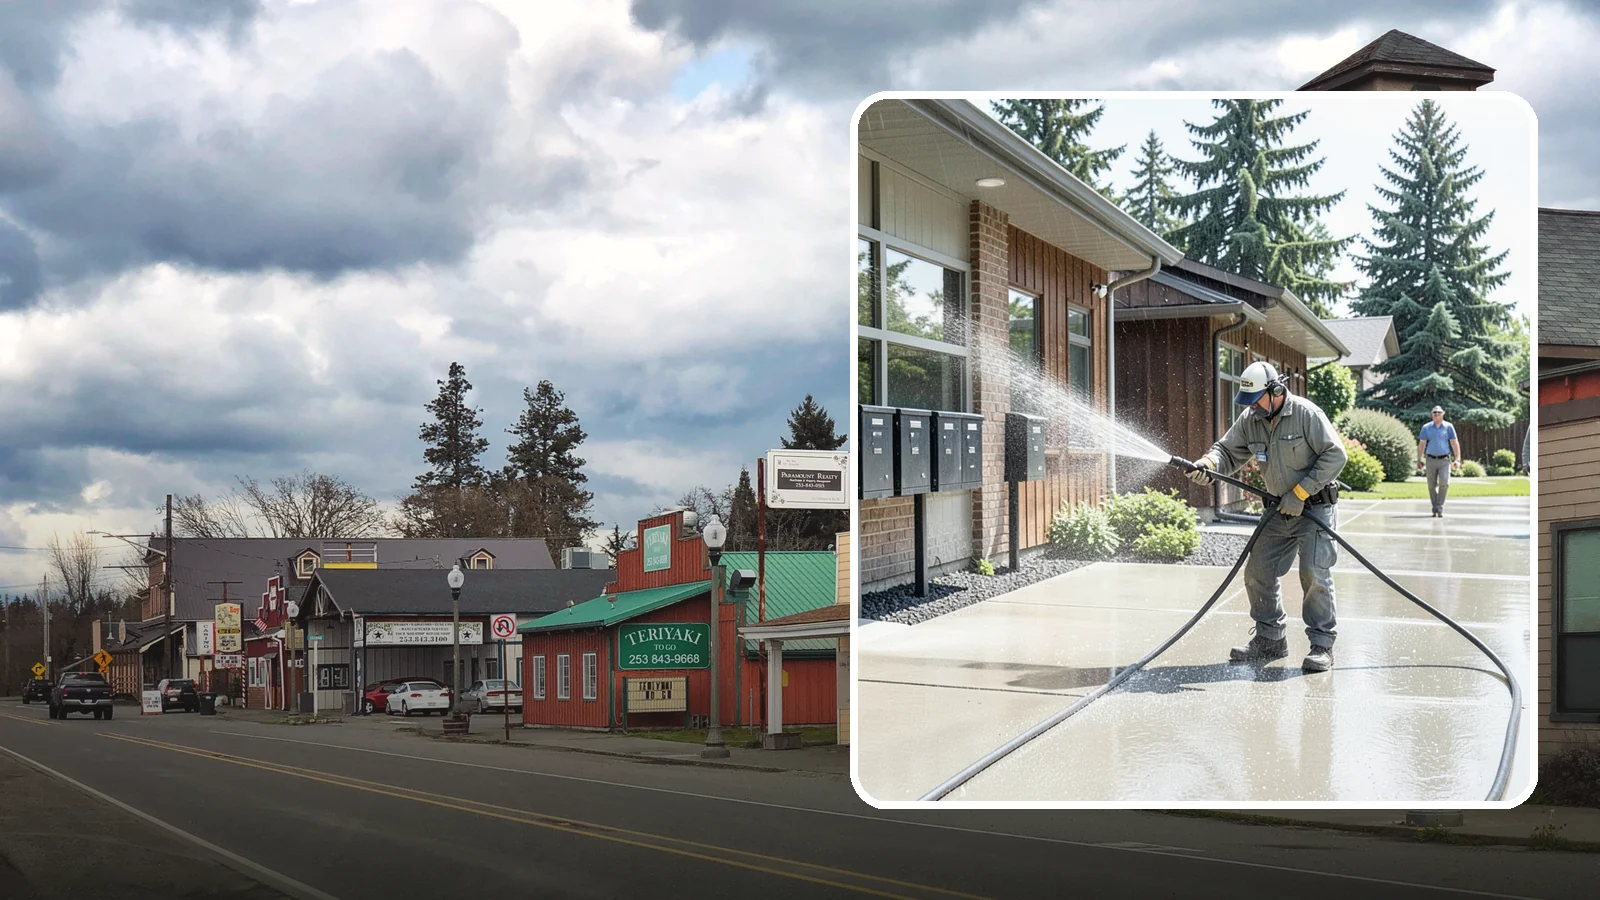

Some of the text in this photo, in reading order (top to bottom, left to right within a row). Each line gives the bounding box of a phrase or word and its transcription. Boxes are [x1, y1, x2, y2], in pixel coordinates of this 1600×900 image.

[624, 627, 702, 646] TERIYAKI
[628, 654, 700, 665] 253 843-9668
